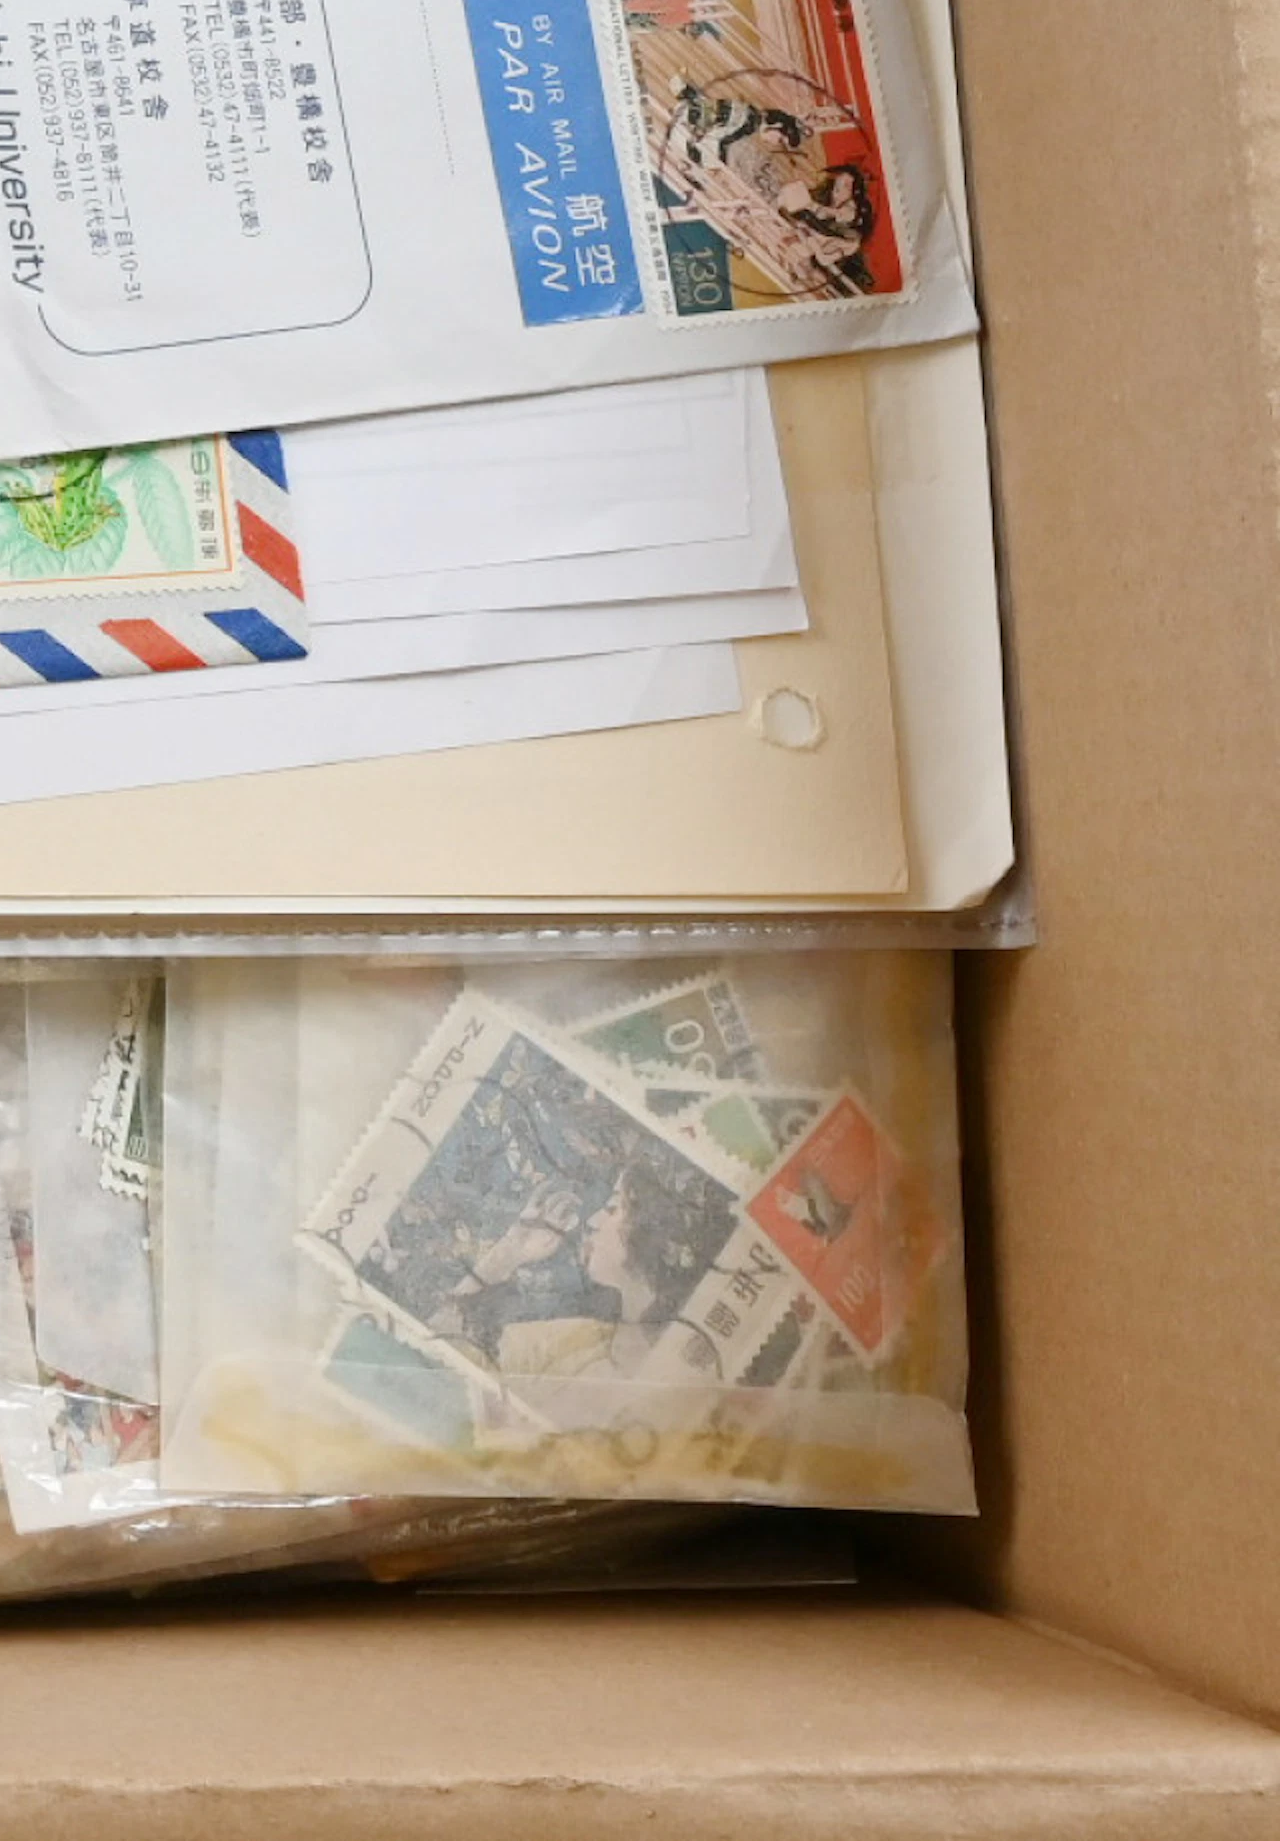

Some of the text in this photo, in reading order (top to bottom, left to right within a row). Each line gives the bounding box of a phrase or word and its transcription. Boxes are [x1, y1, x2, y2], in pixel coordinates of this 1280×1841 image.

[492, 19, 571, 294] PAR AVION
[531, 14, 619, 289] BY AIR MAIL 航空
[686, 246, 724, 305] 130
